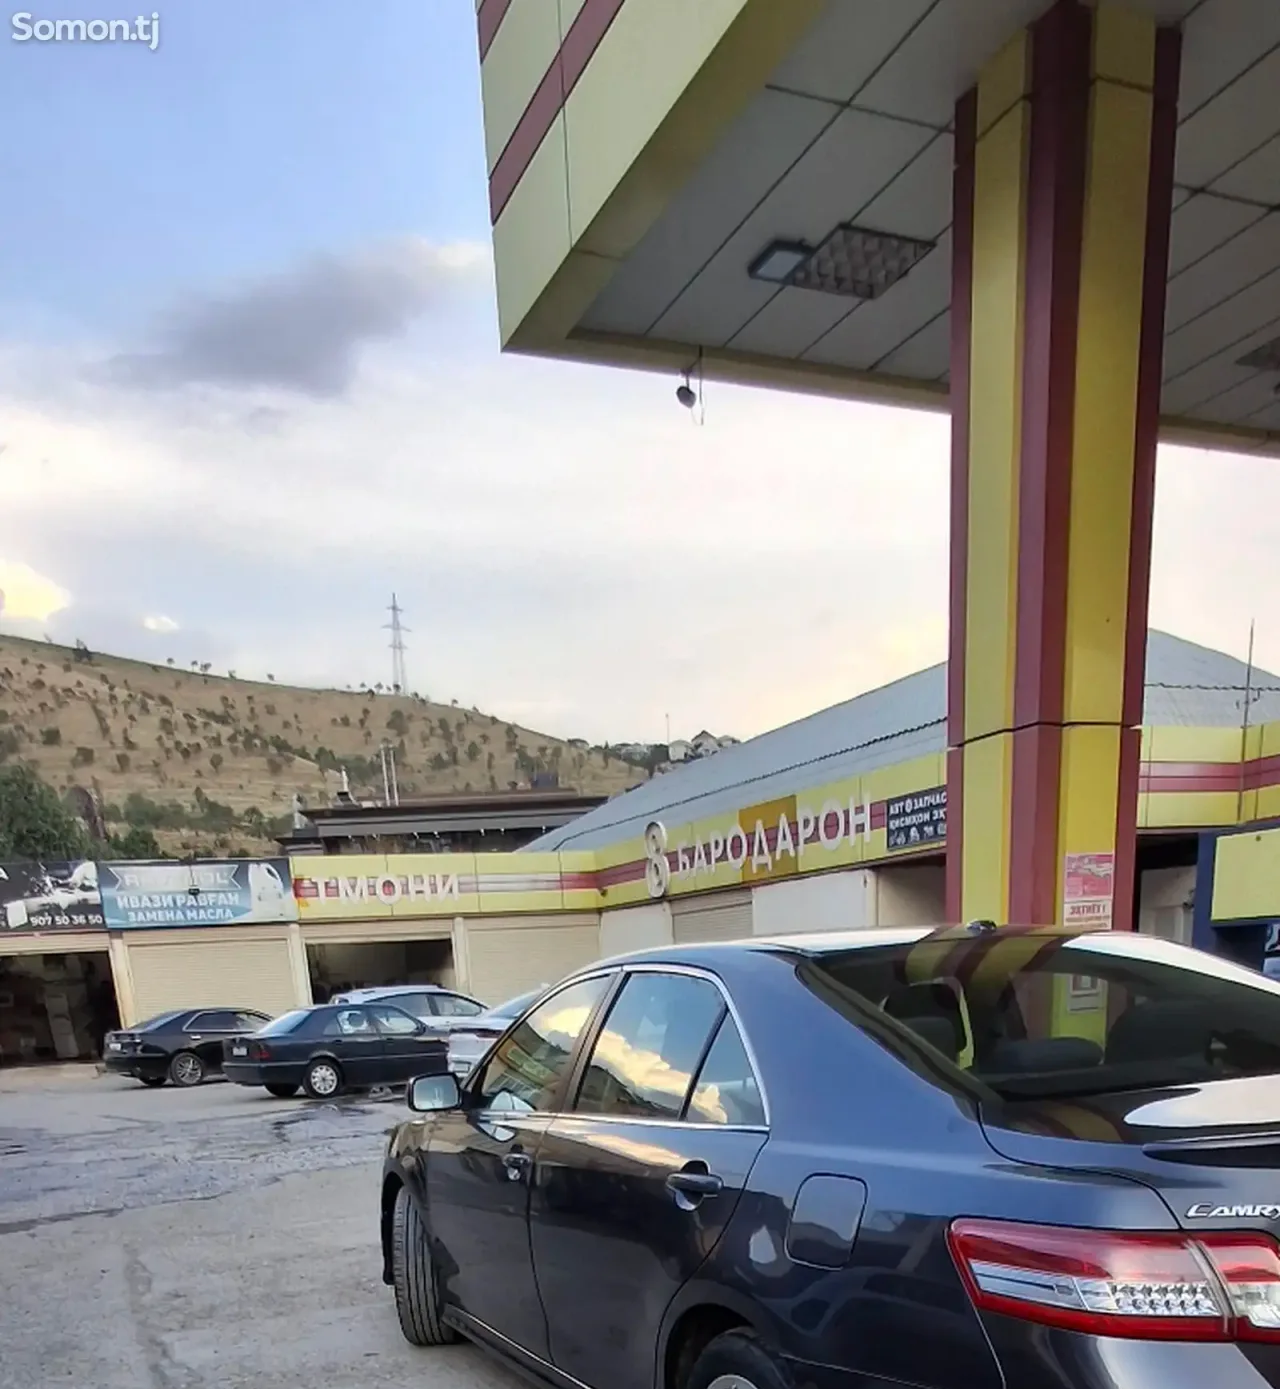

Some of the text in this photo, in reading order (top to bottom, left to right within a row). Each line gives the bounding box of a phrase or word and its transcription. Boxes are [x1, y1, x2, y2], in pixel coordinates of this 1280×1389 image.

[676, 791, 872, 880] БАРОДАРОН
[310, 872, 460, 906] ТМОНИ
[115, 895, 175, 909] ИВАЗИ
[30, 914, 53, 927] 907
[55, 914, 70, 925] 50
[127, 908, 234, 923] ЗАМЕНА МАСЛА
[1185, 1203, 1280, 1220] CAMRY
